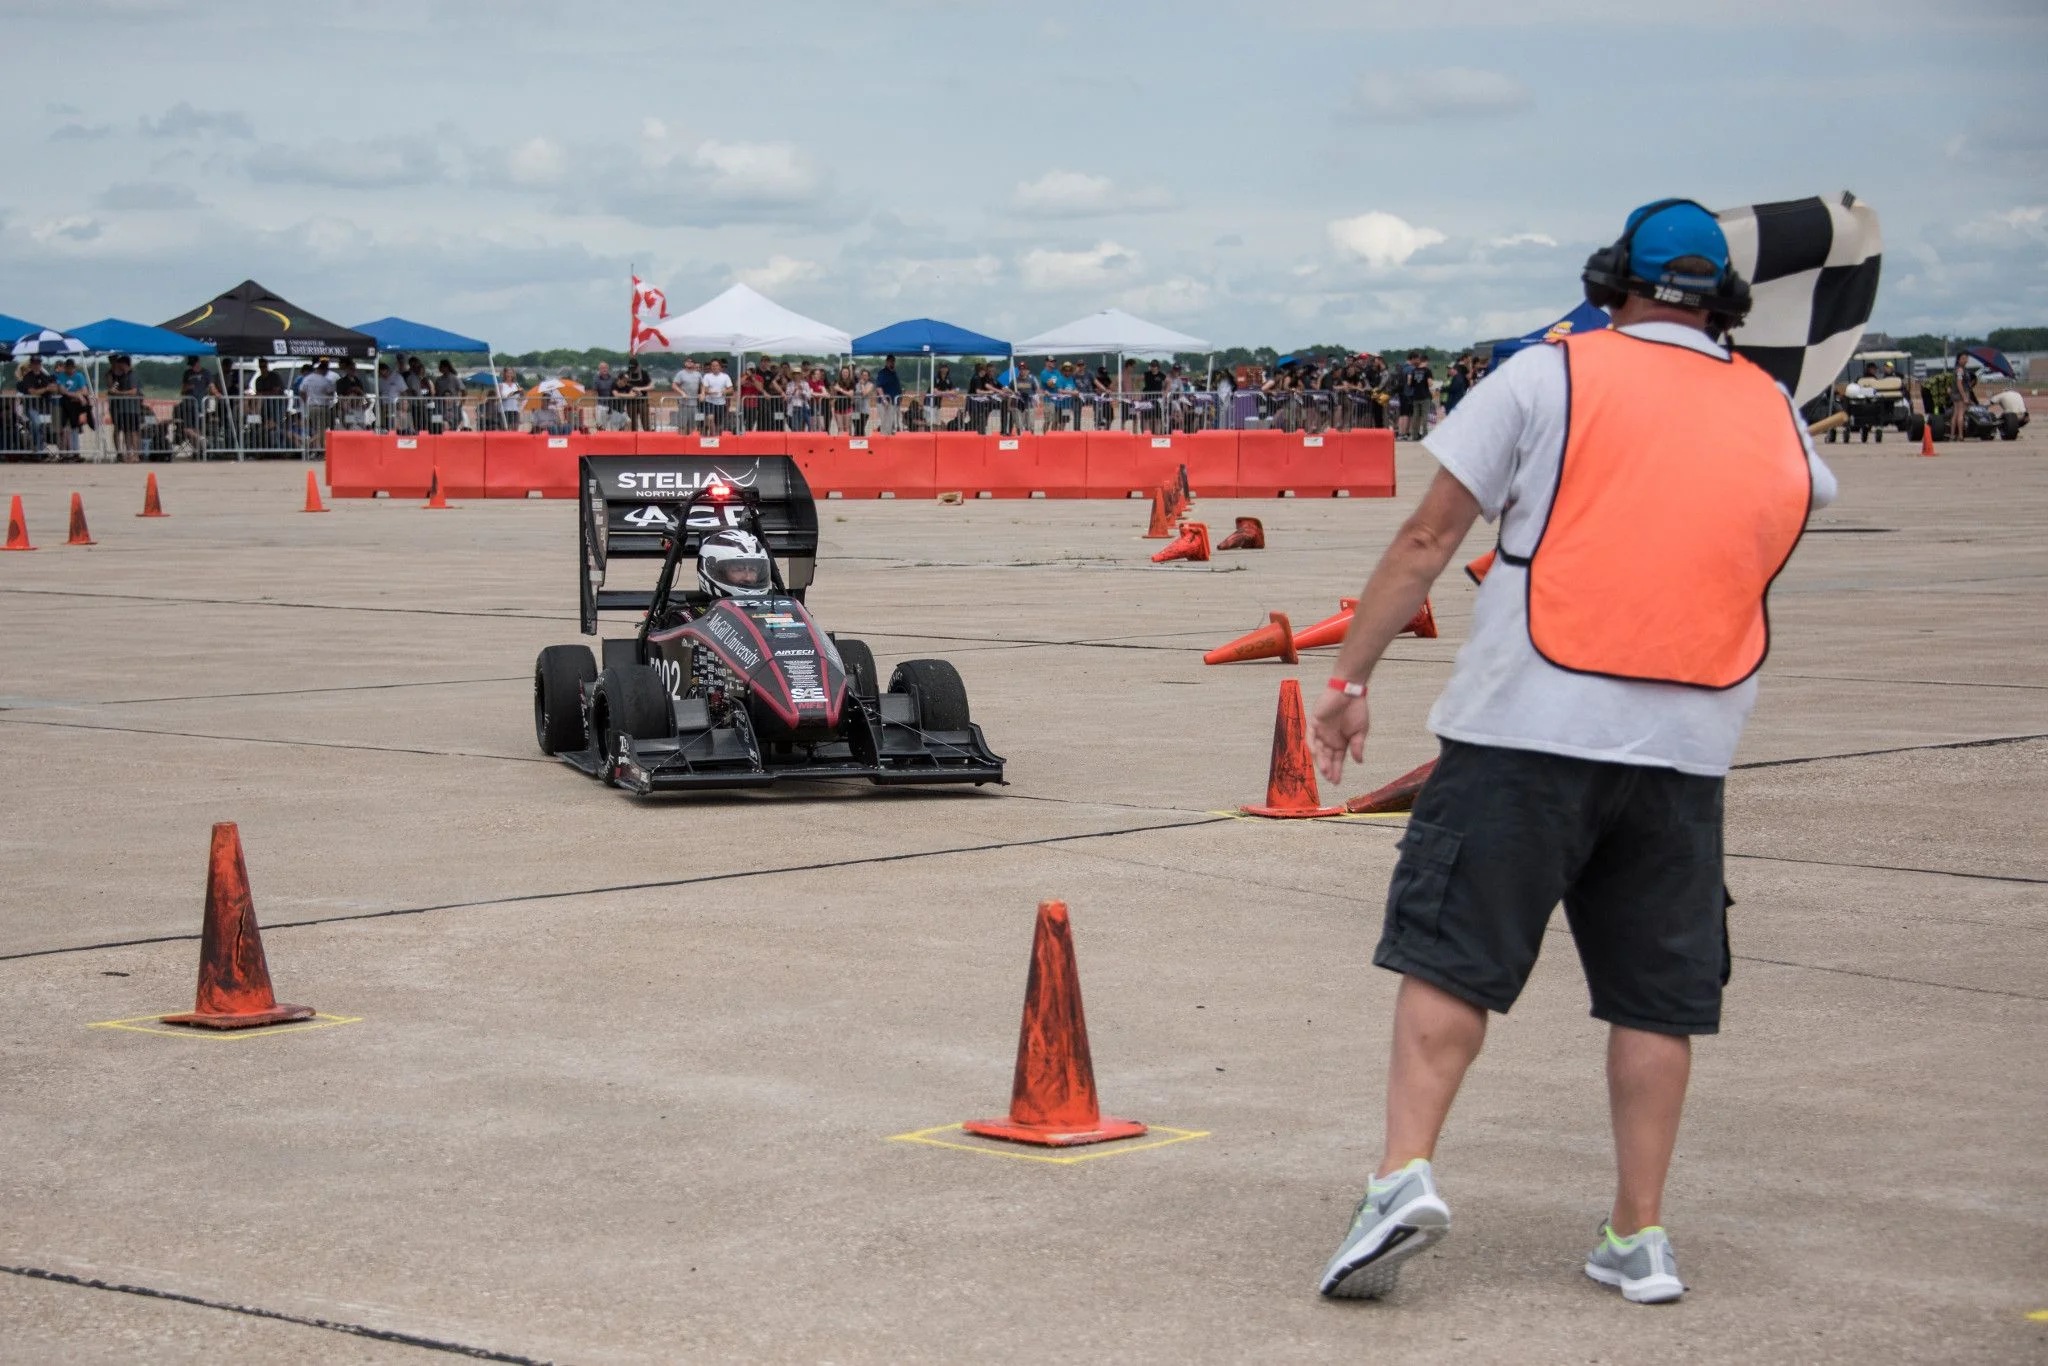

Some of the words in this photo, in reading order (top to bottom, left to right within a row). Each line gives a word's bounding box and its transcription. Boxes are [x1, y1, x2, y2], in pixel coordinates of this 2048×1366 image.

[618, 472, 724, 489] STELIA
[636, 490, 675, 498] NORTH
[707, 612, 733, 640] McGill
[723, 630, 760, 670] University
[774, 649, 815, 657] AIRTECH
[790, 687, 826, 699] SAE
